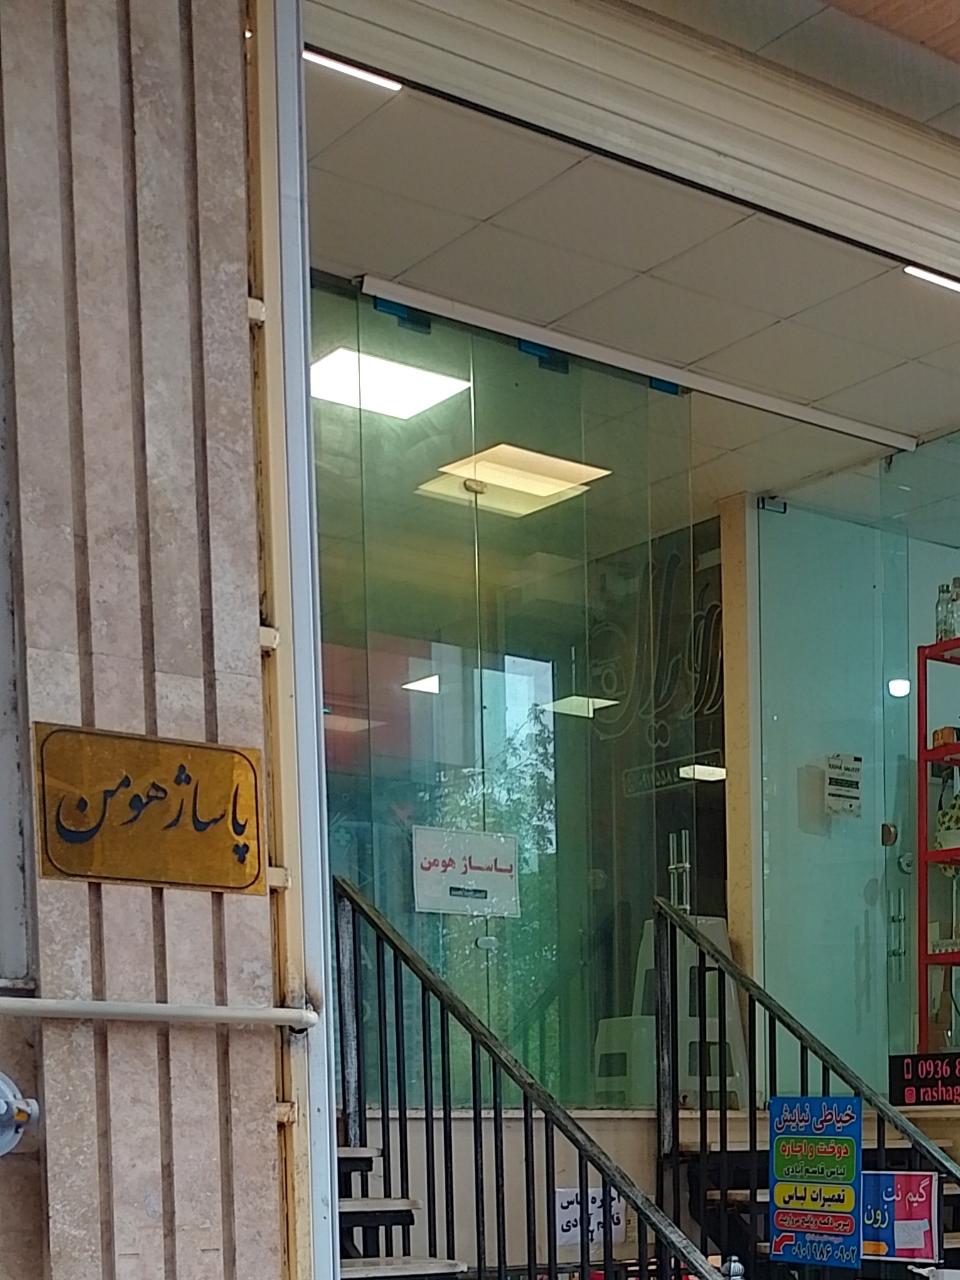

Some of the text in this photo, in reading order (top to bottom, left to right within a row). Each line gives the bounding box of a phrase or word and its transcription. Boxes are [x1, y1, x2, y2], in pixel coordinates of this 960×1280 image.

[55, 763, 250, 865] پاساژ هومن
[420, 855, 513, 880] پاساژ هومن
[918, 1060, 951, 1079] 0936
[812, 1102, 856, 1133] خیاطی
[783, 1186, 807, 1205] لباس
[882, 1177, 930, 1211] گیم نت
[864, 1204, 889, 1228] زون
